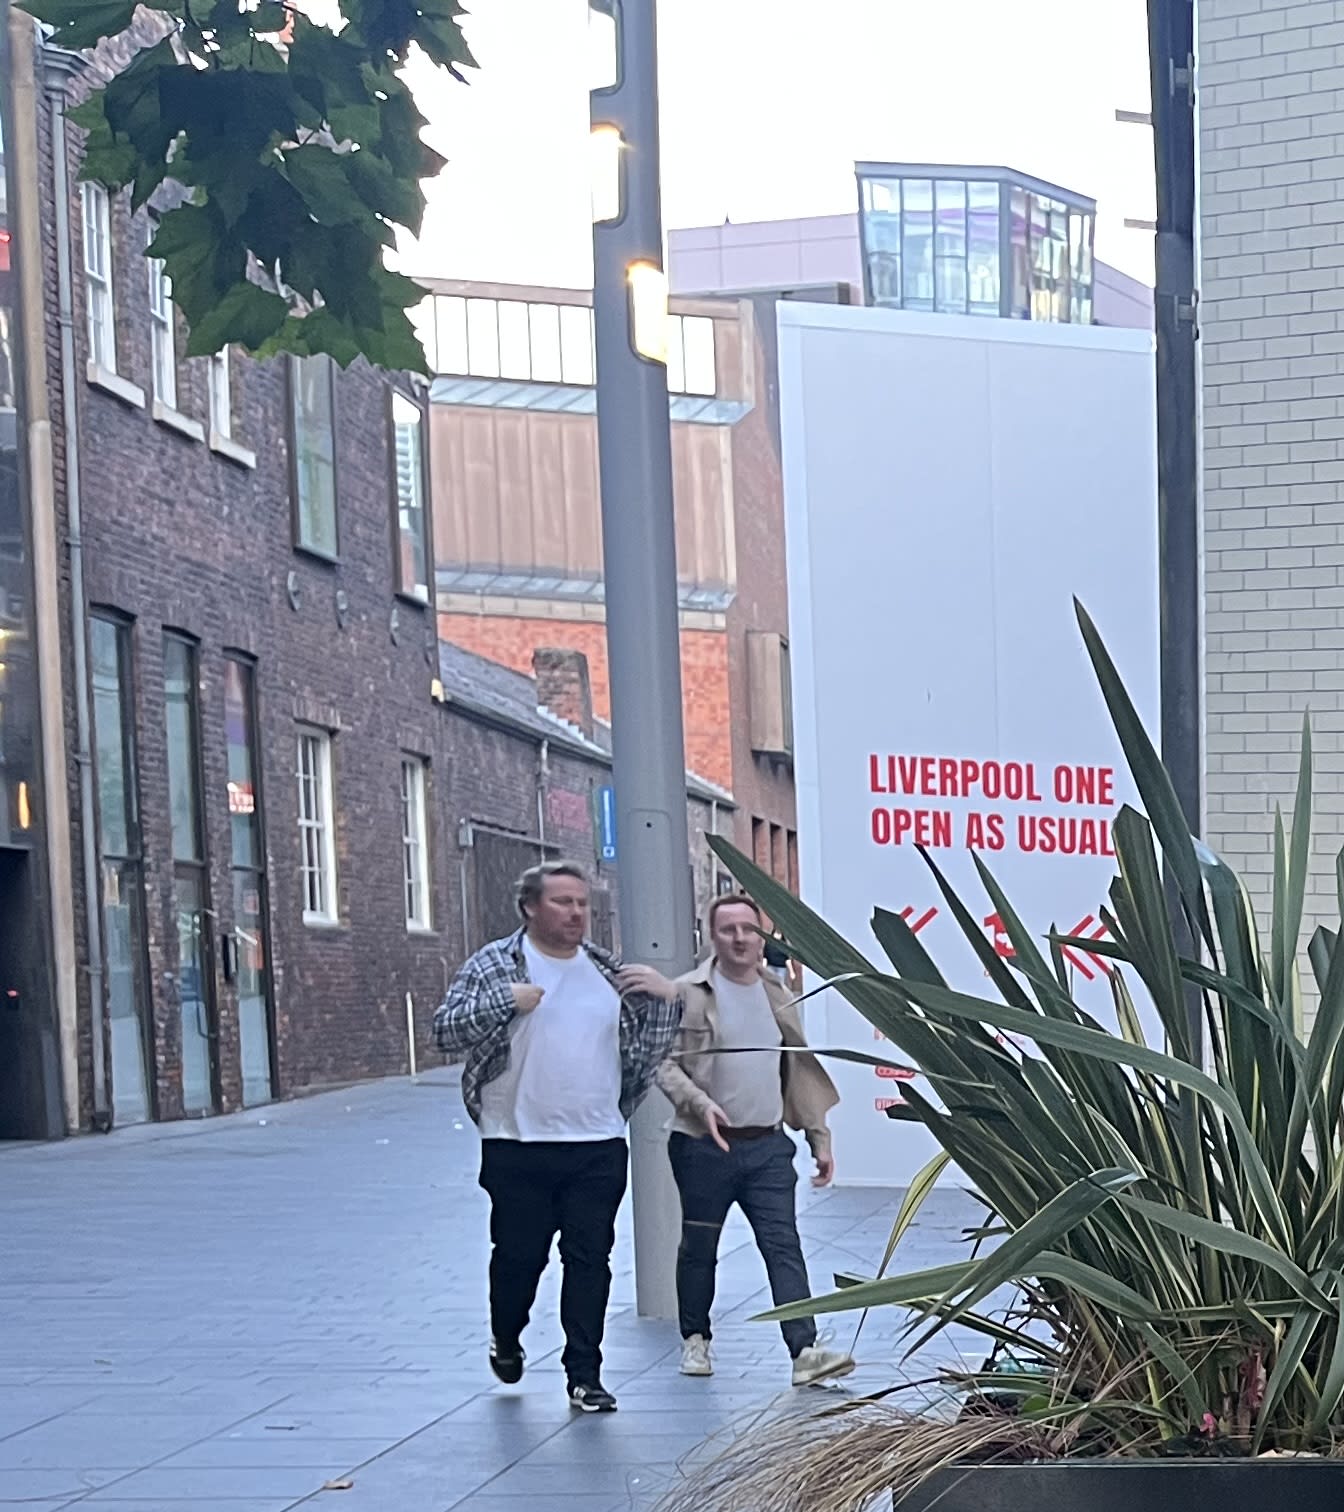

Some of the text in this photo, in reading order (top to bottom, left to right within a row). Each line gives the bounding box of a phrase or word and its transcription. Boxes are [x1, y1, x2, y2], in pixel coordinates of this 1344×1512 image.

[870, 754, 1114, 805] LIVERPOOL ONE
[872, 808, 1115, 856] OPEN AS USUAL
